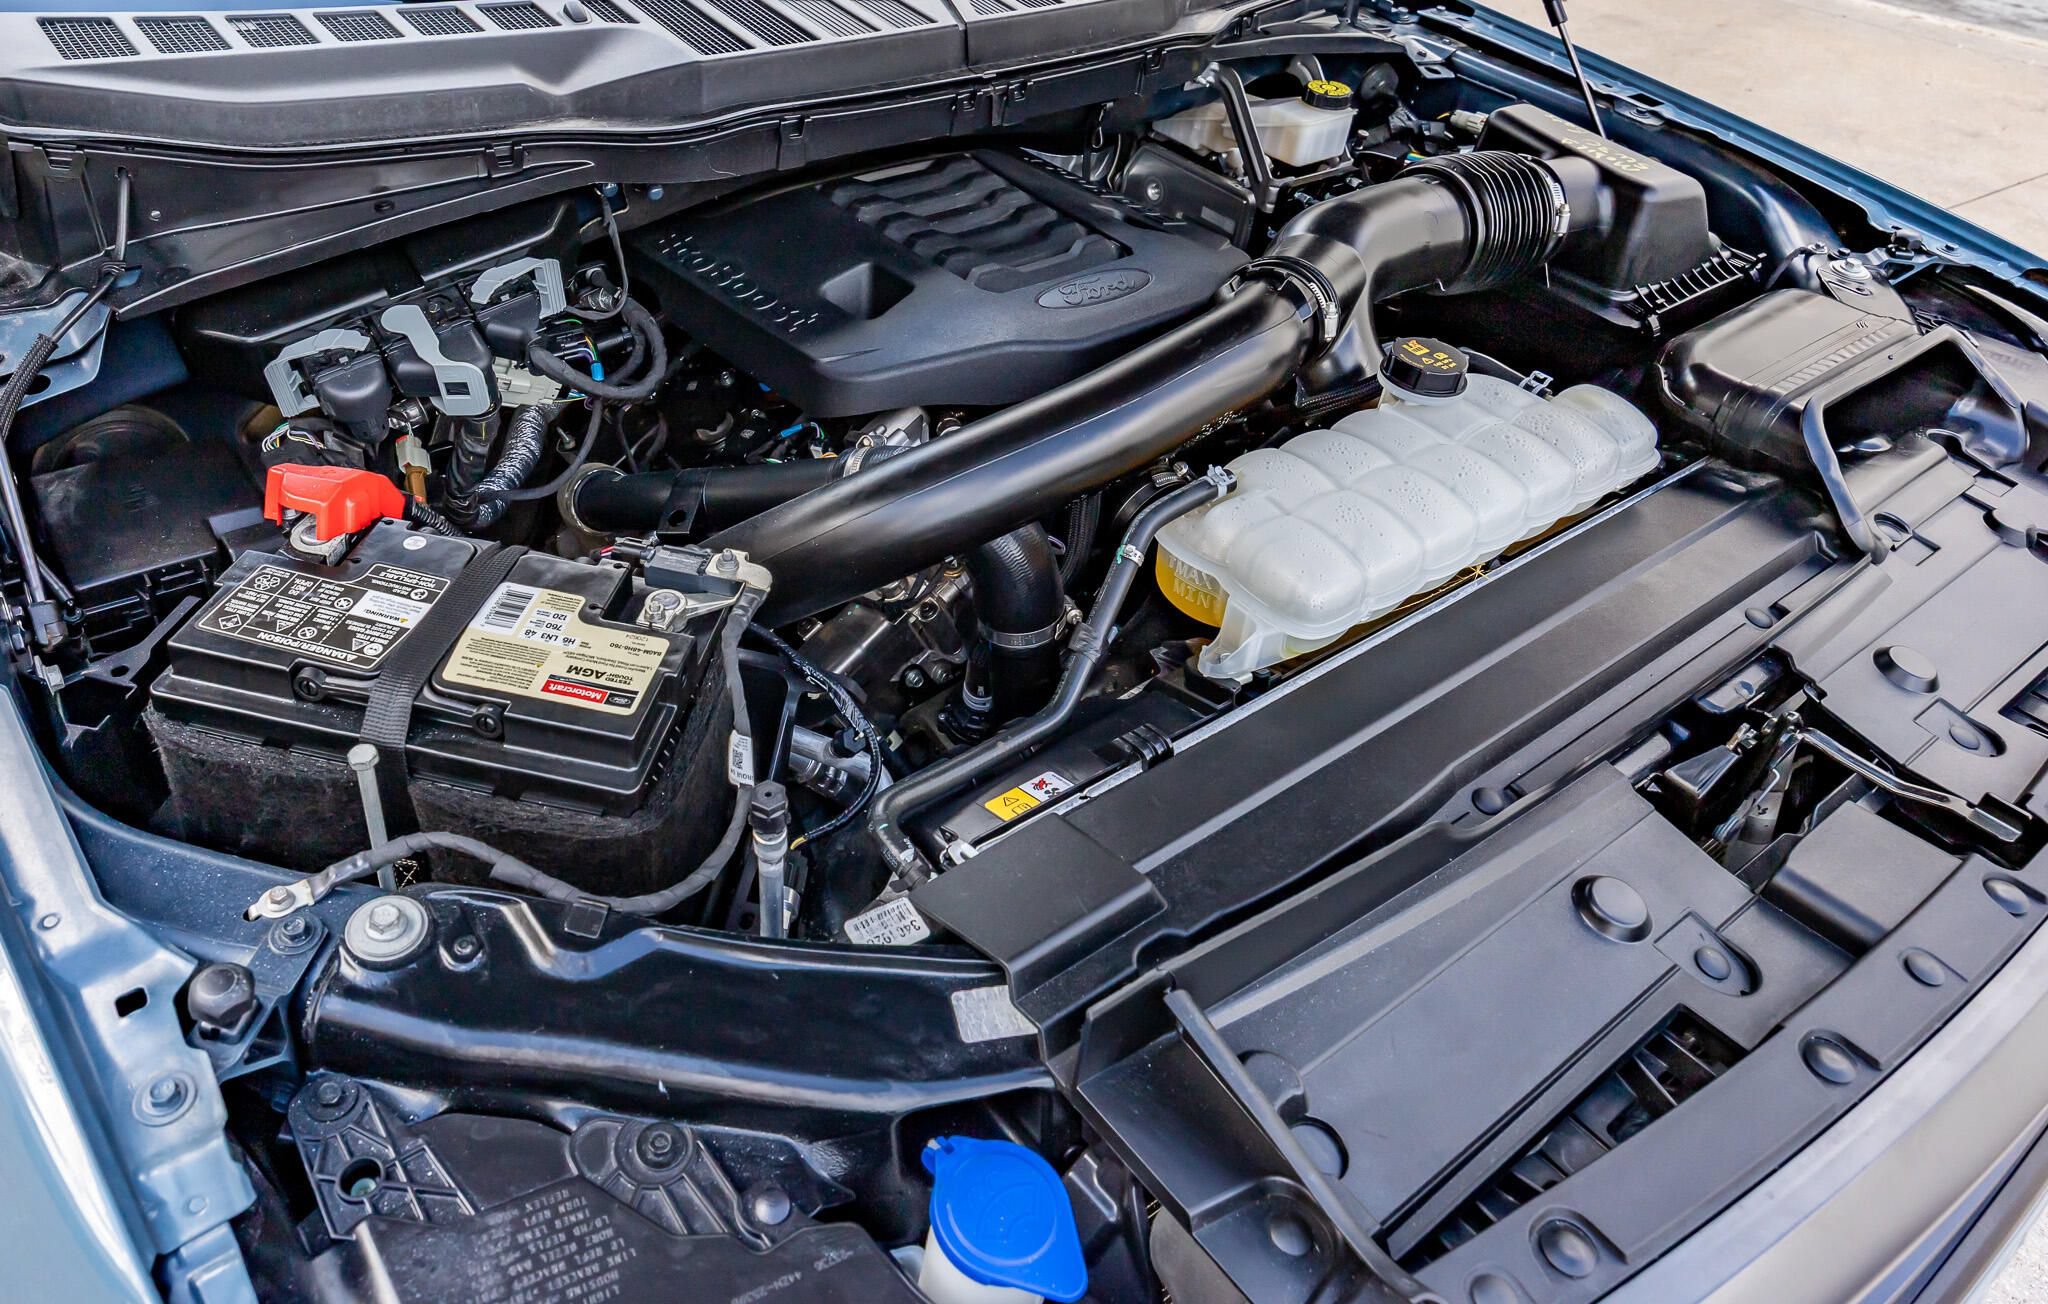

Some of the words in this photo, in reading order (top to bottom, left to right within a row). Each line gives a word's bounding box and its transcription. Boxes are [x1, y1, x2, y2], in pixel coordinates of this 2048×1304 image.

[1056, 271, 1140, 304] Ford
[552, 613, 568, 621] 120
[545, 622, 564, 631] 760
[541, 633, 559, 641] LN3
[257, 632, 349, 659] DANGER/POISON
[566, 665, 607, 680] AGM
[548, 683, 603, 699] Motorcraft
